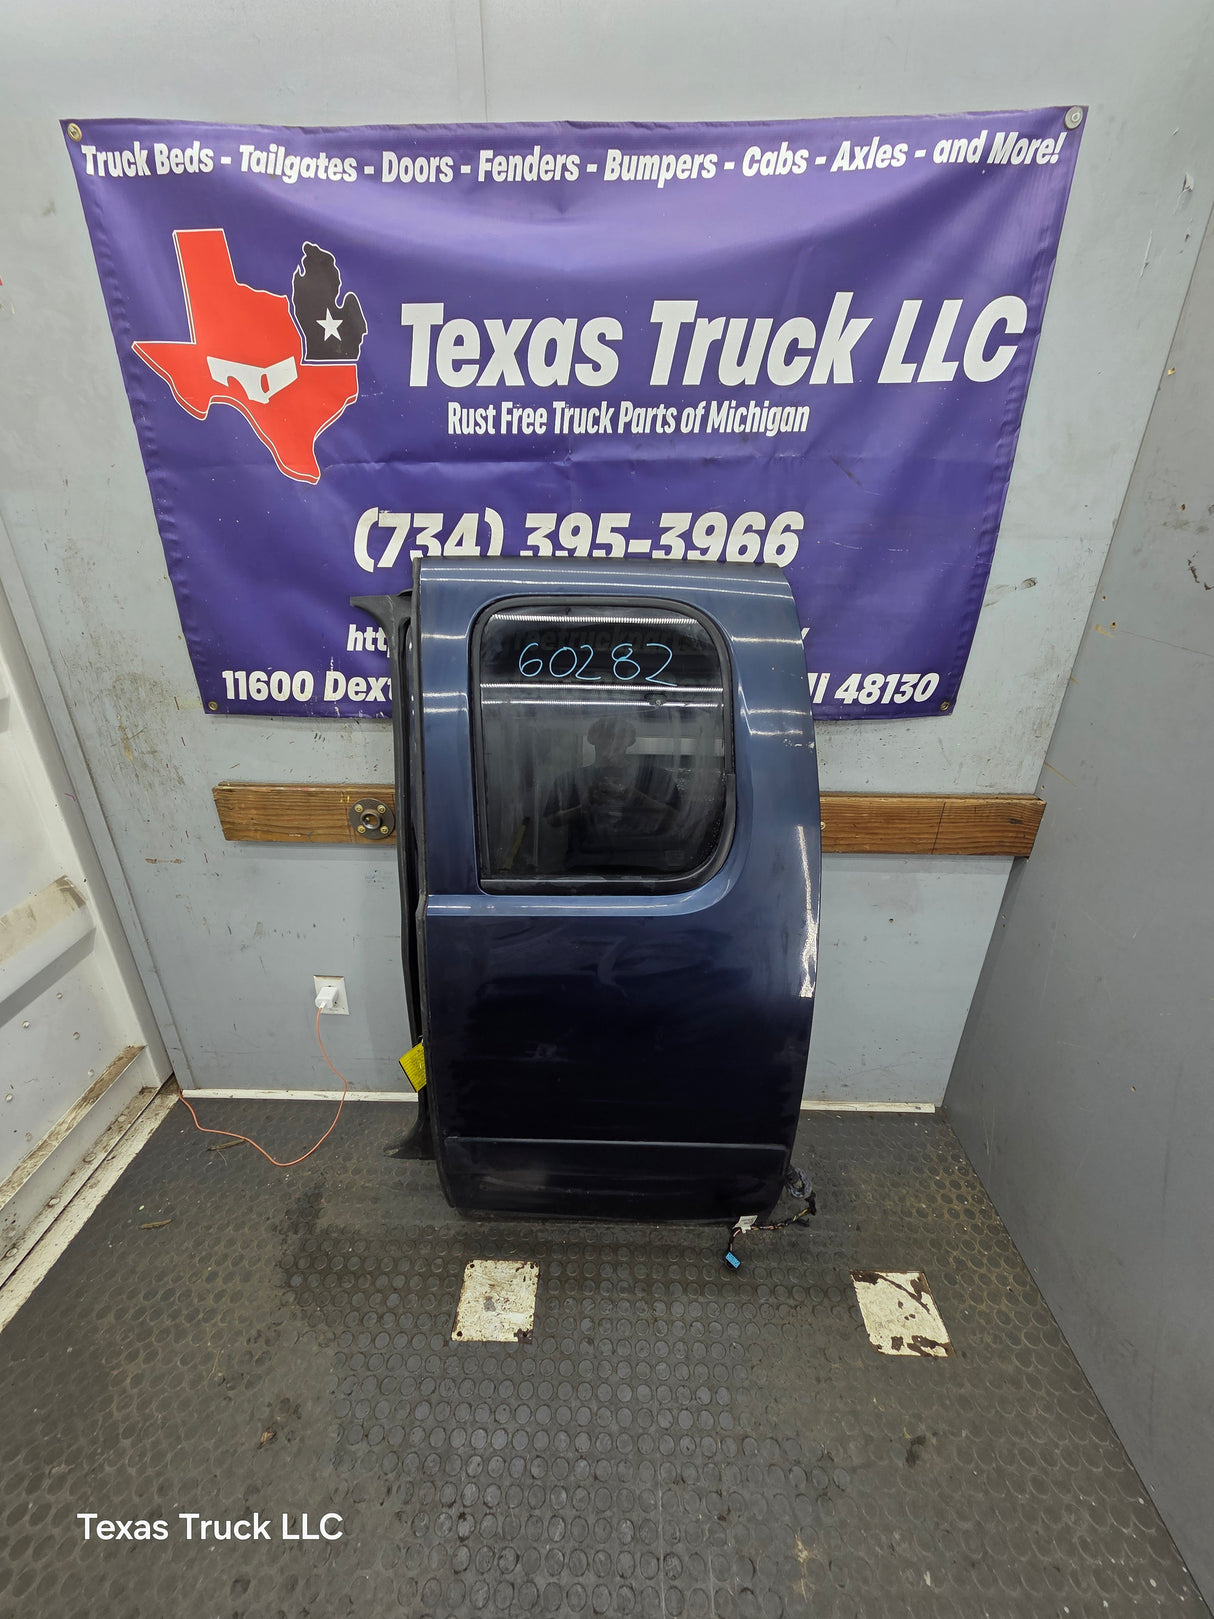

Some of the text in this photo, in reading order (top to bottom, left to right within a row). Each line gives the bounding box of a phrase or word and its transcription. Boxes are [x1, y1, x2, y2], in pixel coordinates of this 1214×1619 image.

[80, 140, 152, 178] Truck
[153, 140, 215, 175] Beds
[238, 143, 358, 185] Tailgates
[381, 151, 454, 184] Doors
[477, 145, 581, 182] Fenders
[603, 148, 718, 189] Bumpers
[741, 141, 810, 177] Cabs
[829, 135, 909, 173] Axles
[932, 129, 988, 164] and
[988, 131, 1067, 165] More!
[400, 291, 1028, 388] Texas Truck LLC
[448, 399, 810, 437] Rust Free Truck Parts of Michigan
[353, 506, 805, 573] (734) 395-3966
[221, 670, 314, 702] 11600
[833, 672, 940, 705] 48130
